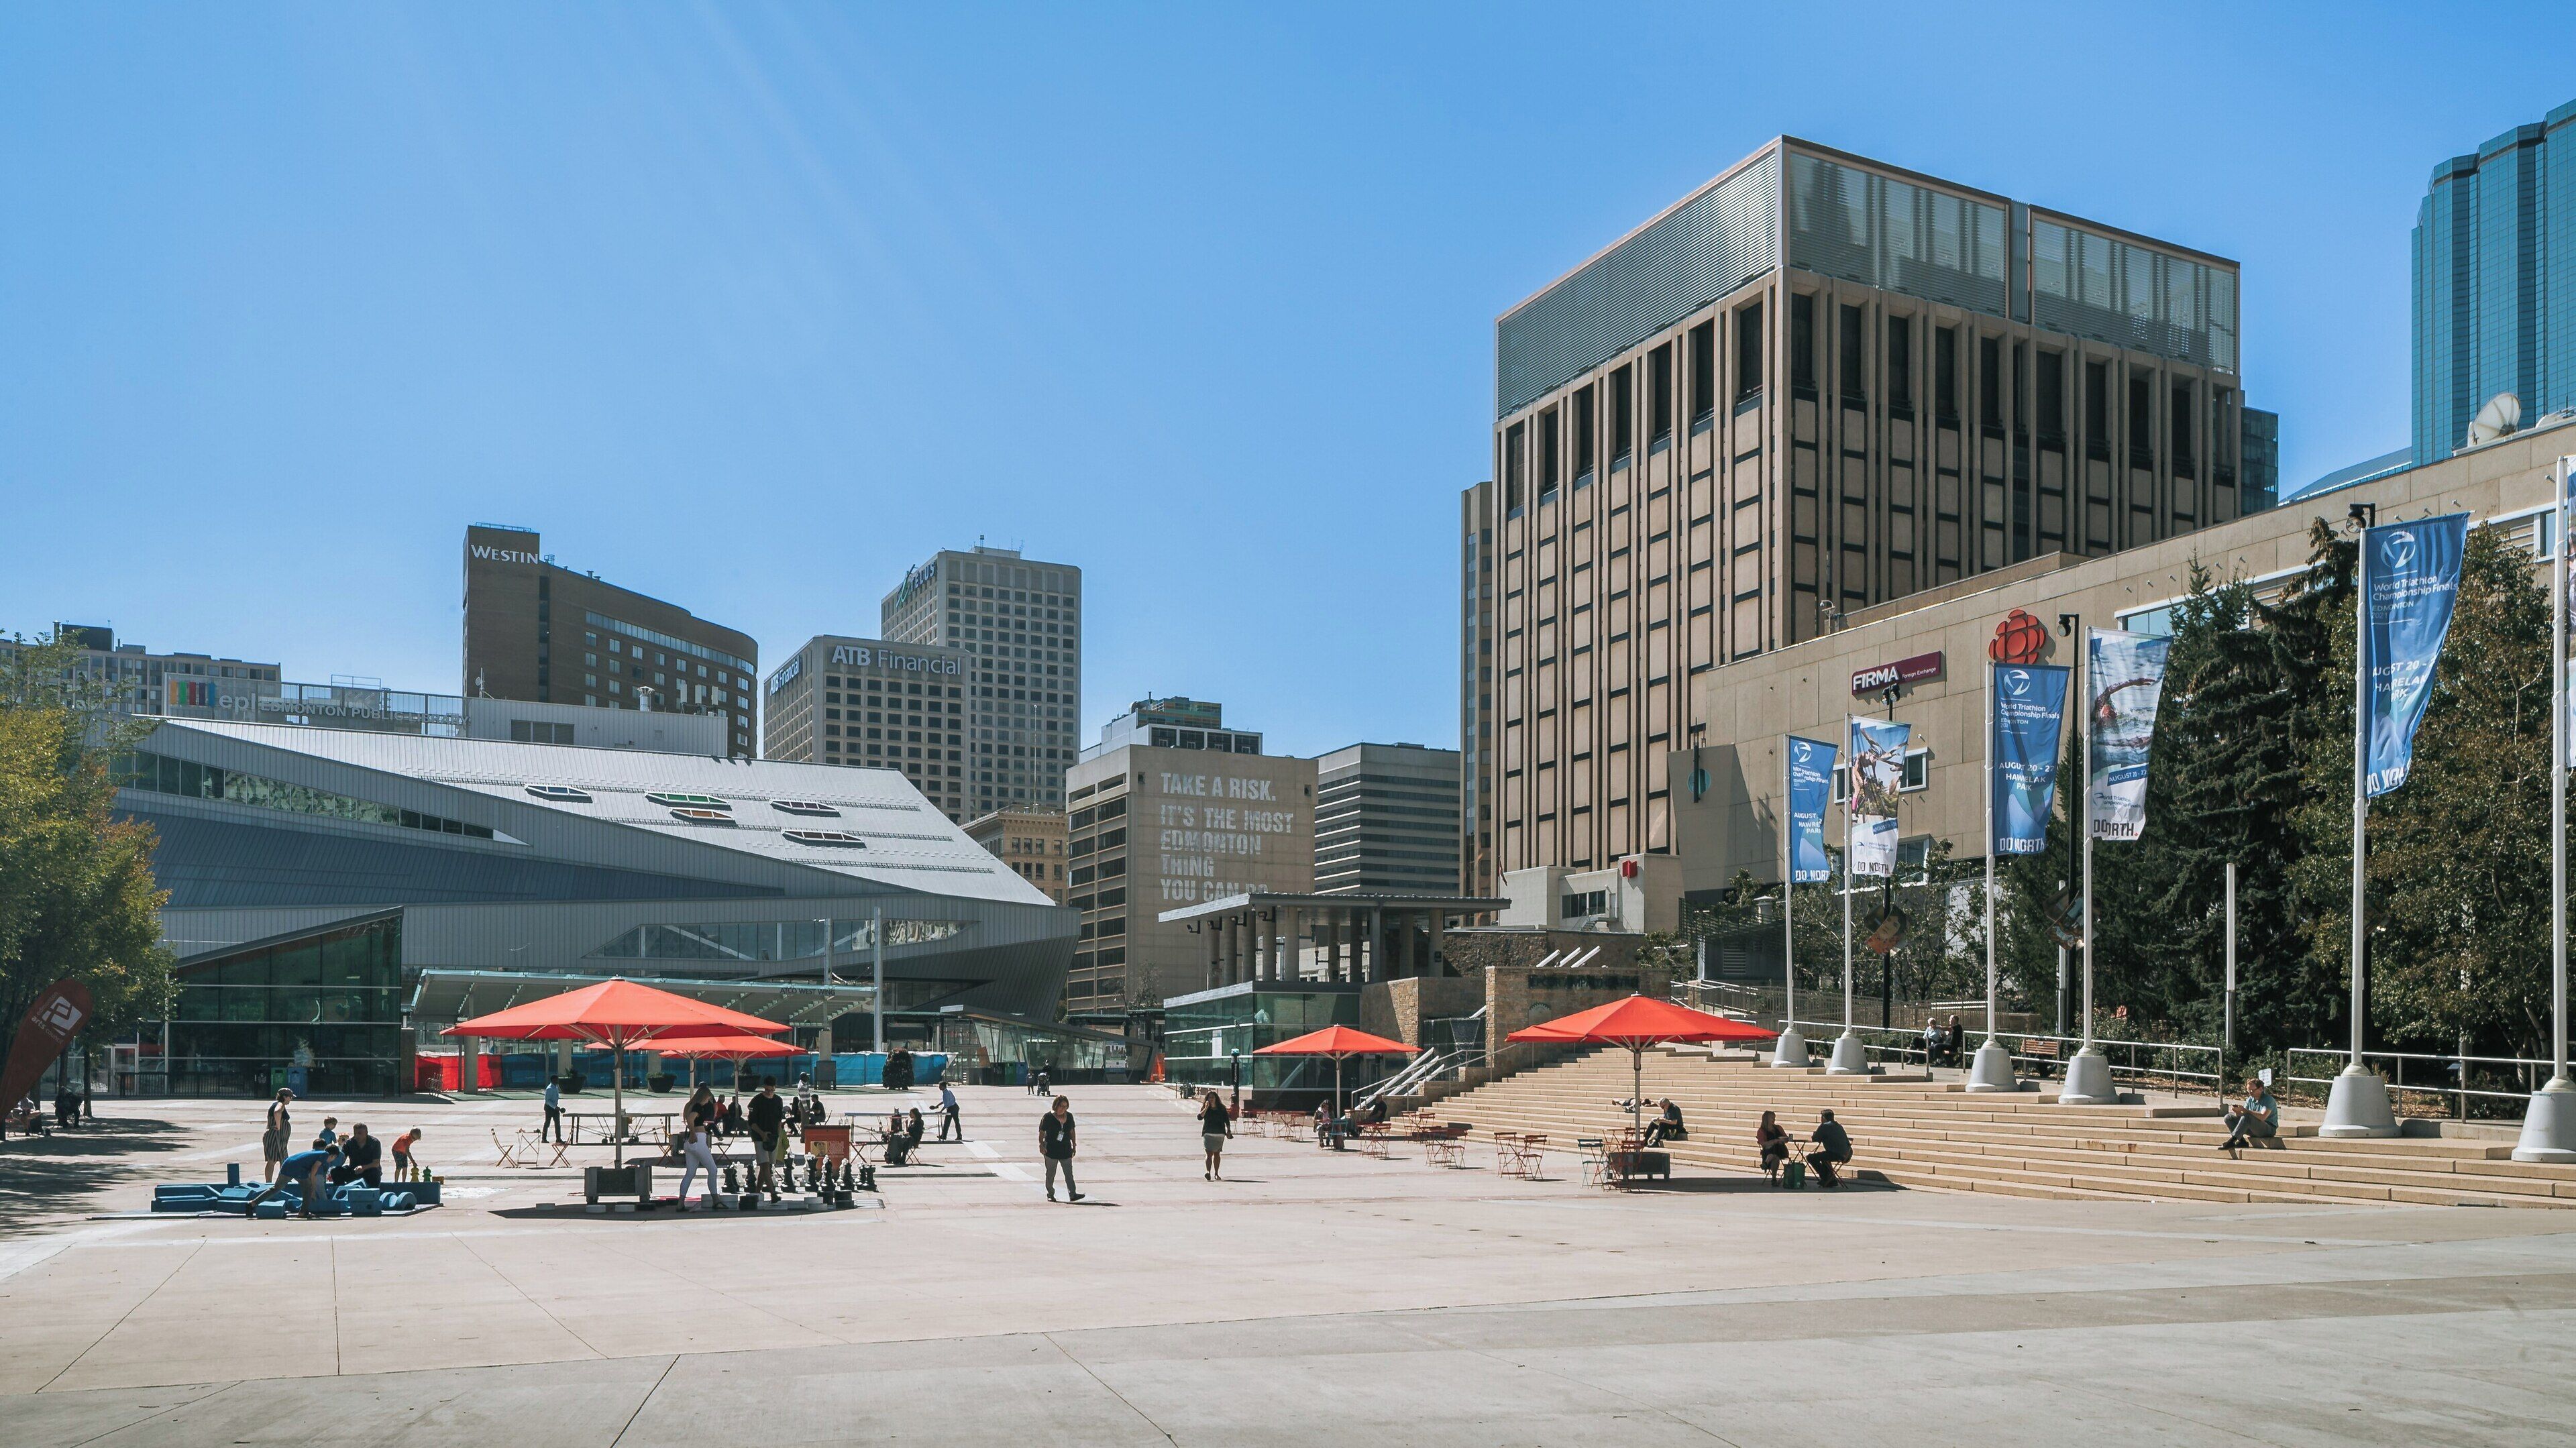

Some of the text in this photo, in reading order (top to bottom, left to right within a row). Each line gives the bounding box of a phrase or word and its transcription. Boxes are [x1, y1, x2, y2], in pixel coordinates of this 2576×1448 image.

[471, 545, 538, 565] WESTIN
[910, 562, 934, 592] TELUS
[2374, 576, 2438, 592] World Triathlon
[2373, 582, 2458, 601] Championship Finals
[2372, 601, 2414, 612] EDMONTON
[831, 645, 961, 675] ATB Financial
[2406, 660, 2419, 671] 20
[770, 655, 799, 696] ATB Financial
[1853, 666, 1900, 691] FIRMA
[1917, 667, 1937, 675] Exchange
[219, 692, 470, 726] epl EDMONTON PUBLIC LIBRARY
[2017, 704, 2046, 712] Triathlon
[1161, 772, 1277, 801] TAKE A RISK.
[2108, 773, 2132, 782] AUGUST
[1161, 805, 1294, 834] IT'S THE MOST
[1161, 829, 1261, 856] EDMONTON
[2000, 837, 2013, 852] DO
[1161, 854, 1214, 878] THING
[1795, 869, 1830, 881] DO NORT
[1858, 861, 1889, 875] DO NOTH
[1161, 879, 1196, 901] YOU
[1203, 881, 1240, 901] CAN
[32, 1016, 46, 1029] arts
